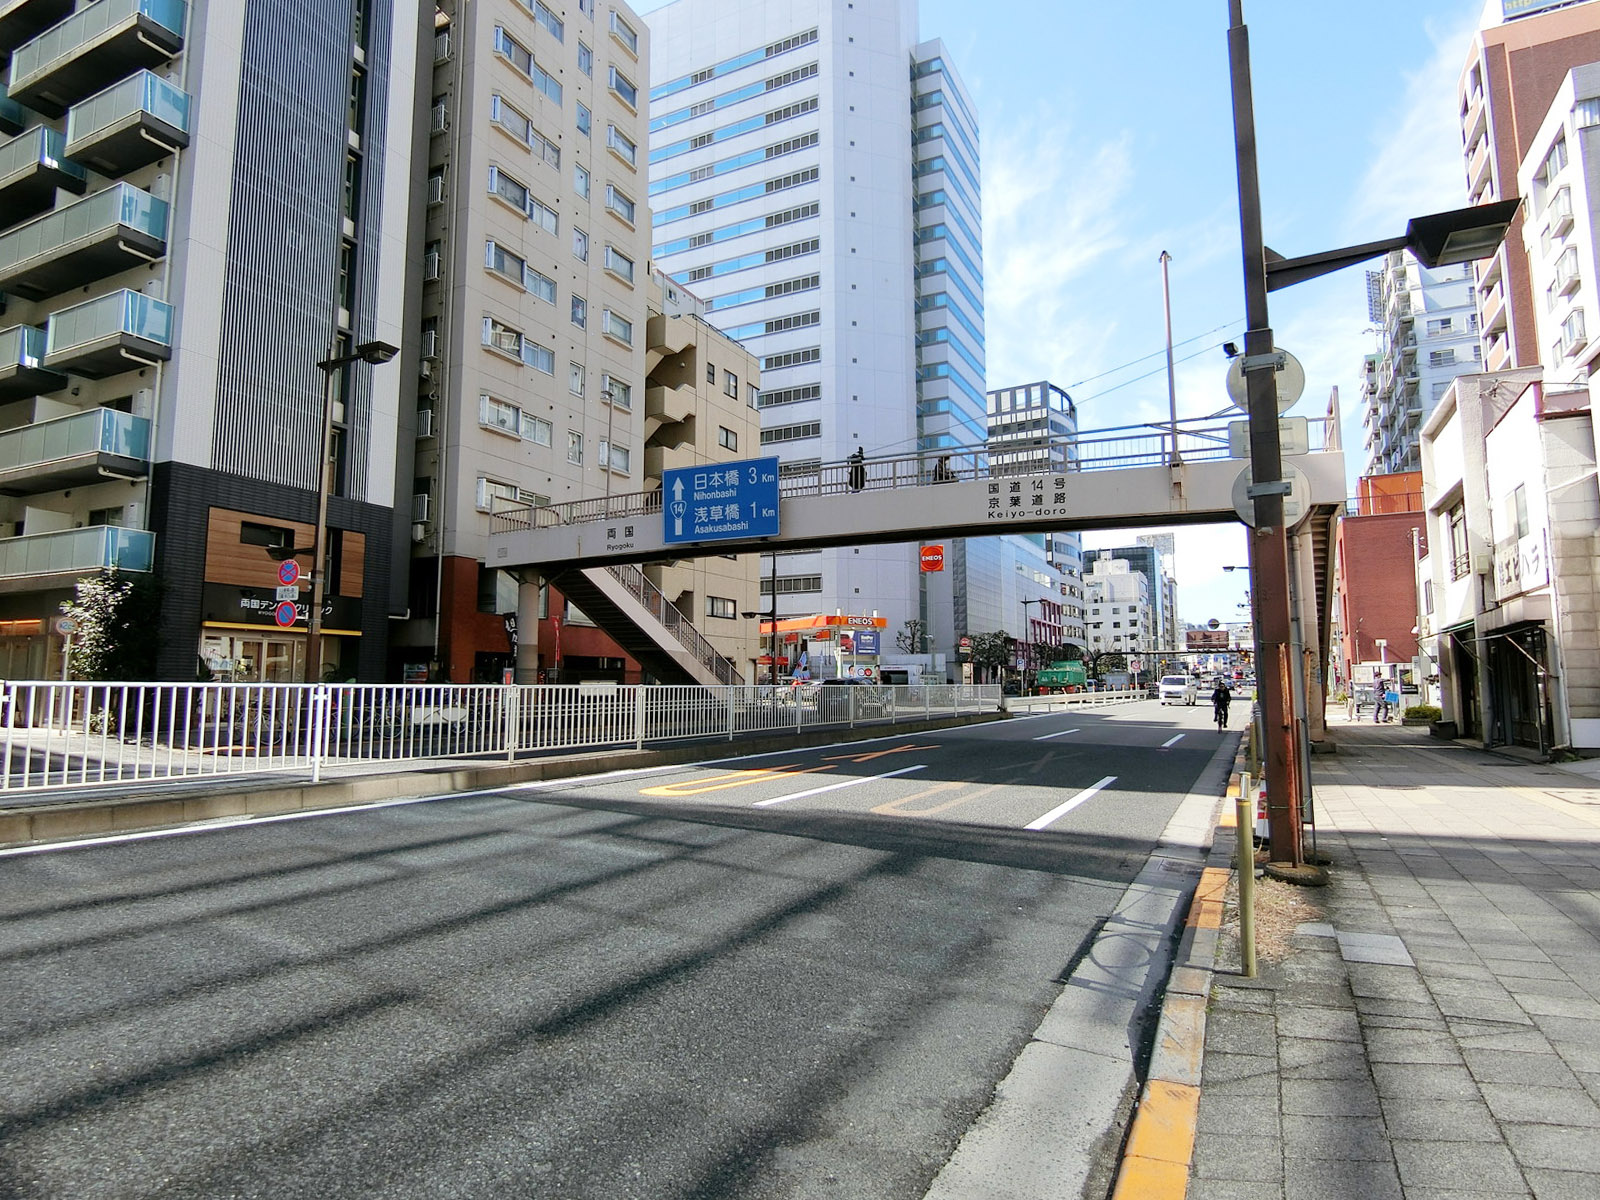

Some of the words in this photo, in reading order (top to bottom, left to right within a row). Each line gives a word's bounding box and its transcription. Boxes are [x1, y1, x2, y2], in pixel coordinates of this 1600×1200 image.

[694, 470, 740, 490] 日本橋
[748, 467, 757, 485] 3
[762, 473, 775, 483] Km
[988, 478, 1066, 495] 国道14号
[694, 488, 737, 500] Nihonbashi
[988, 492, 1066, 509] 京葉道路
[674, 503, 683, 514] 14
[694, 503, 740, 523] 浅草橋
[750, 501, 757, 518] 1
[762, 508, 775, 517] Km
[987, 507, 1067, 519] Keiyo-doro
[606, 525, 634, 540] 両国
[694, 521, 749, 535] Asakusabashi
[606, 542, 634, 551] Ryogoku
[921, 554, 943, 562] ENEOS
[848, 617, 873, 625] ENEOS
